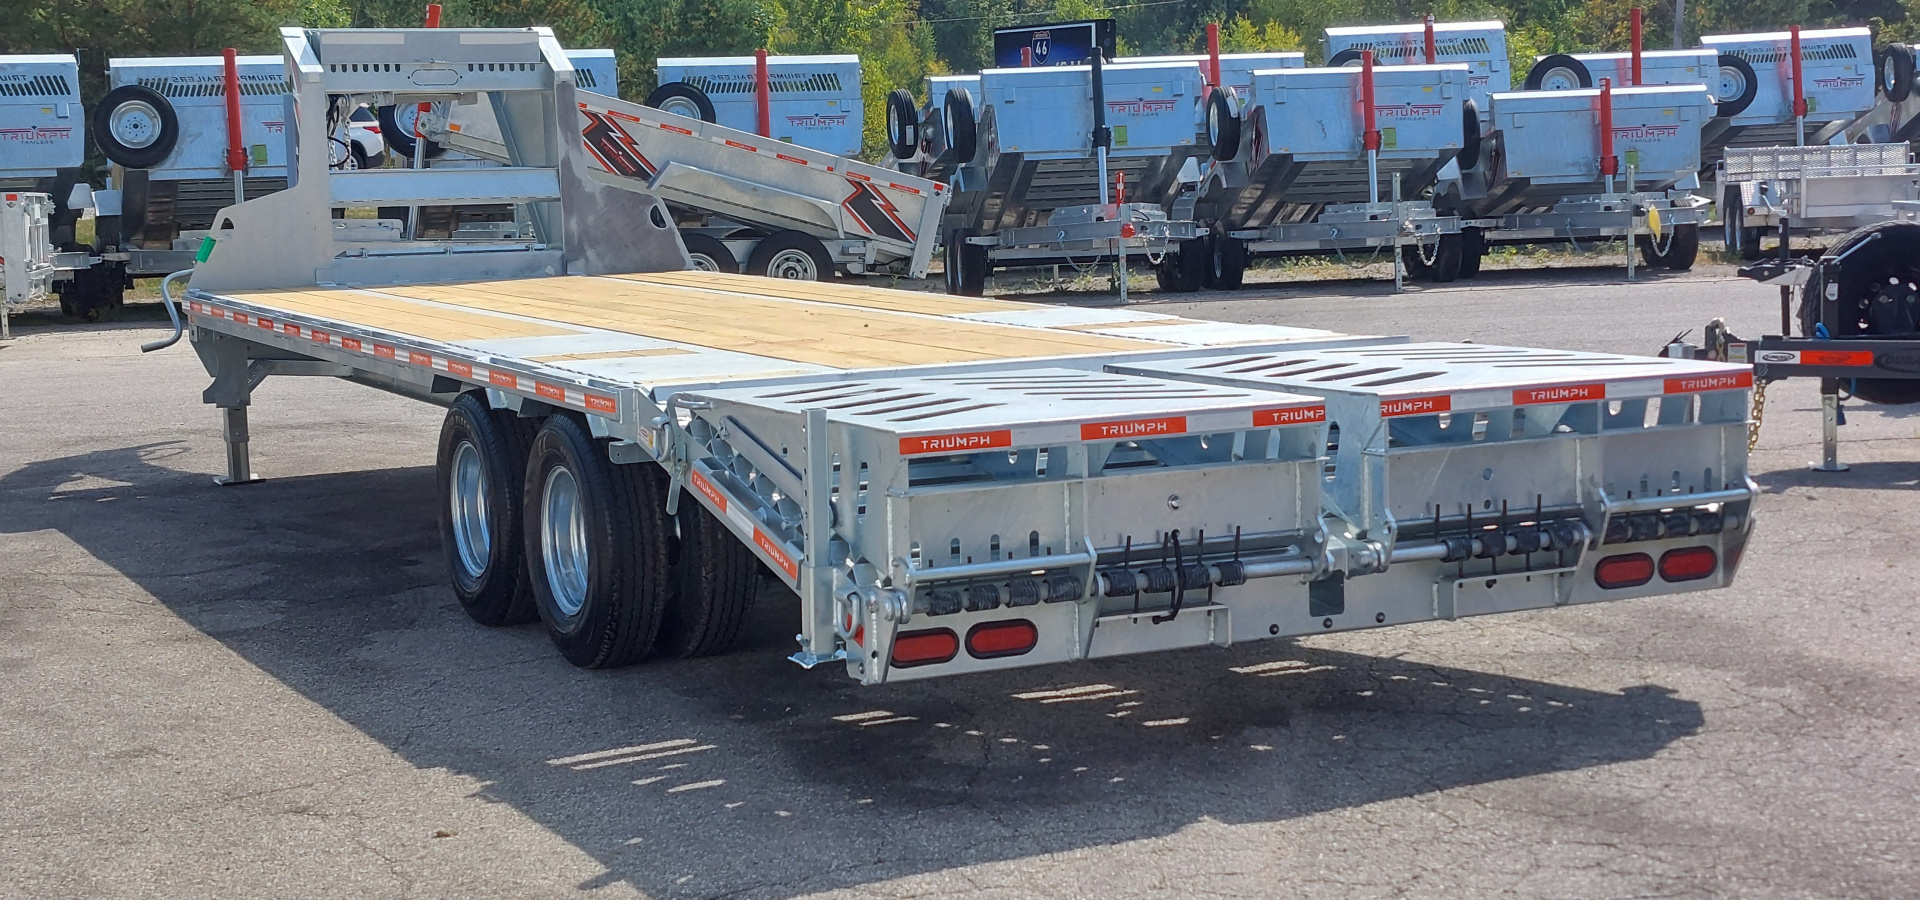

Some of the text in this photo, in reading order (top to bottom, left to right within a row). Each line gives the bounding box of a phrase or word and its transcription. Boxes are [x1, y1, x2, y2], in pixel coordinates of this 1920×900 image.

[1035, 40, 1048, 56] 46
[1816, 80, 1863, 88] TRIUMPH
[1110, 103, 1174, 113] TRIUMPH
[1377, 107, 1441, 117] TRIUMPH
[789, 118, 845, 127] TRIUMPH
[1, 131, 70, 141] TRIUMPH
[1613, 130, 1676, 139] TRIUMPH
[1681, 377, 1736, 390] TRIUMPH
[1530, 388, 1588, 401] TRIUMPH
[1101, 421, 1167, 436] TRIUMPH
[920, 435, 991, 450] TRIUMPH
[693, 474, 720, 504] TRIUMPH
[761, 537, 789, 570] TRIUMPH
